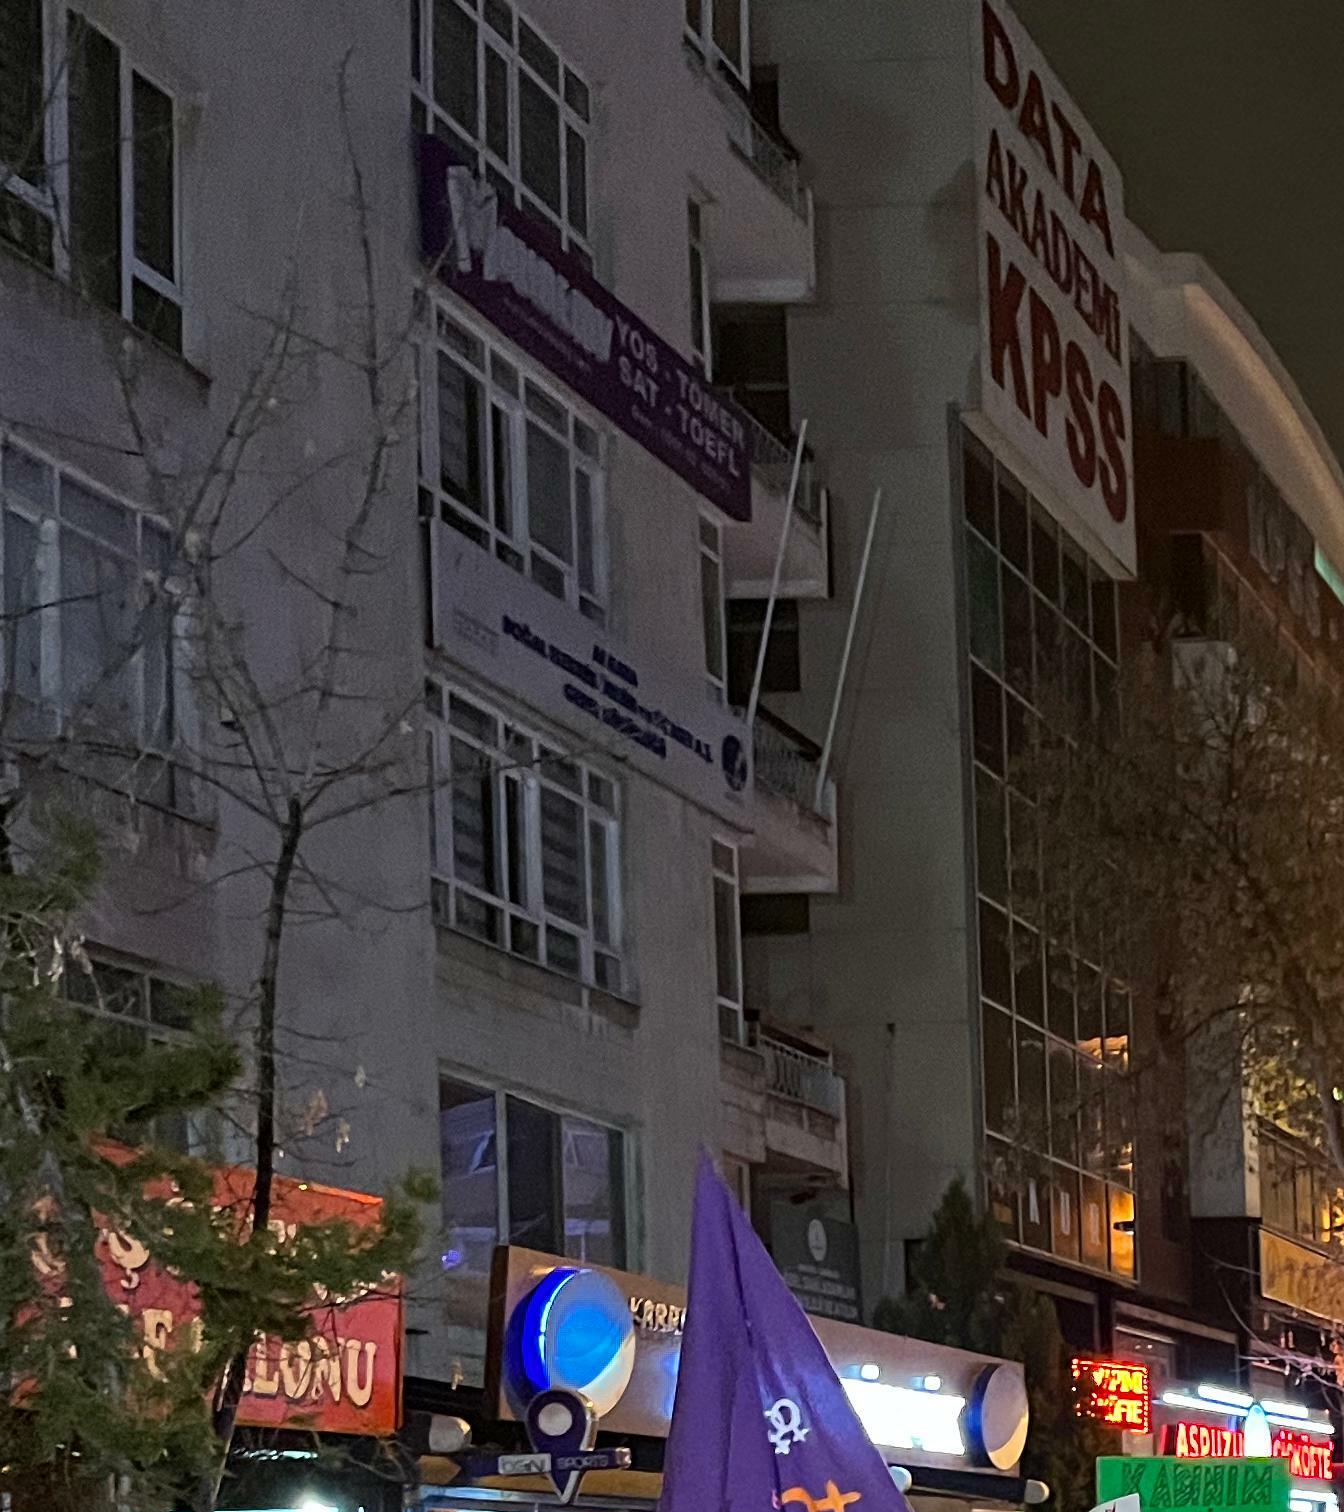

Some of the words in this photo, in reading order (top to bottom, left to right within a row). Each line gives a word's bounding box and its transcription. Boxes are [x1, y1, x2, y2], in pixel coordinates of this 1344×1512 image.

[983, 0, 1115, 258] DATA
[676, 403, 740, 478] TOEFL
[988, 231, 1127, 524] KPSS
